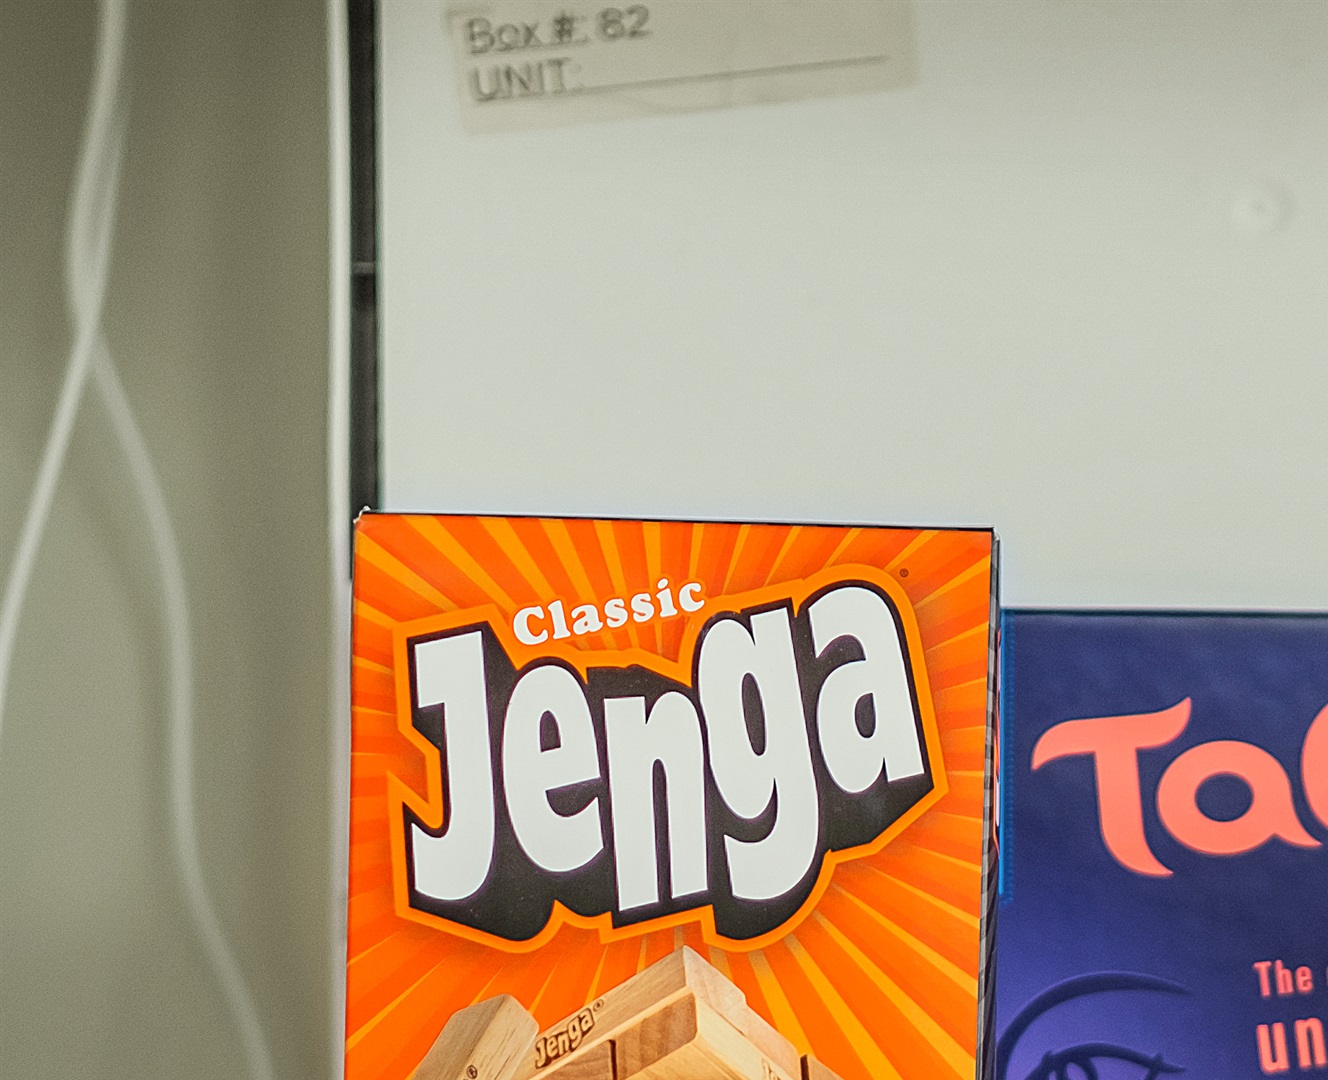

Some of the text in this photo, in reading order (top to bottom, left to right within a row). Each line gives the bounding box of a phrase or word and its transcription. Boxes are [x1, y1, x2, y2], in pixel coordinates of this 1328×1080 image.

[467, 17, 544, 53] Box
[600, 5, 650, 39] 82
[512, 578, 706, 646] Classic
[408, 581, 930, 920] Jenga
[1253, 960, 1314, 997] The
[535, 1008, 595, 1069] Jenga
